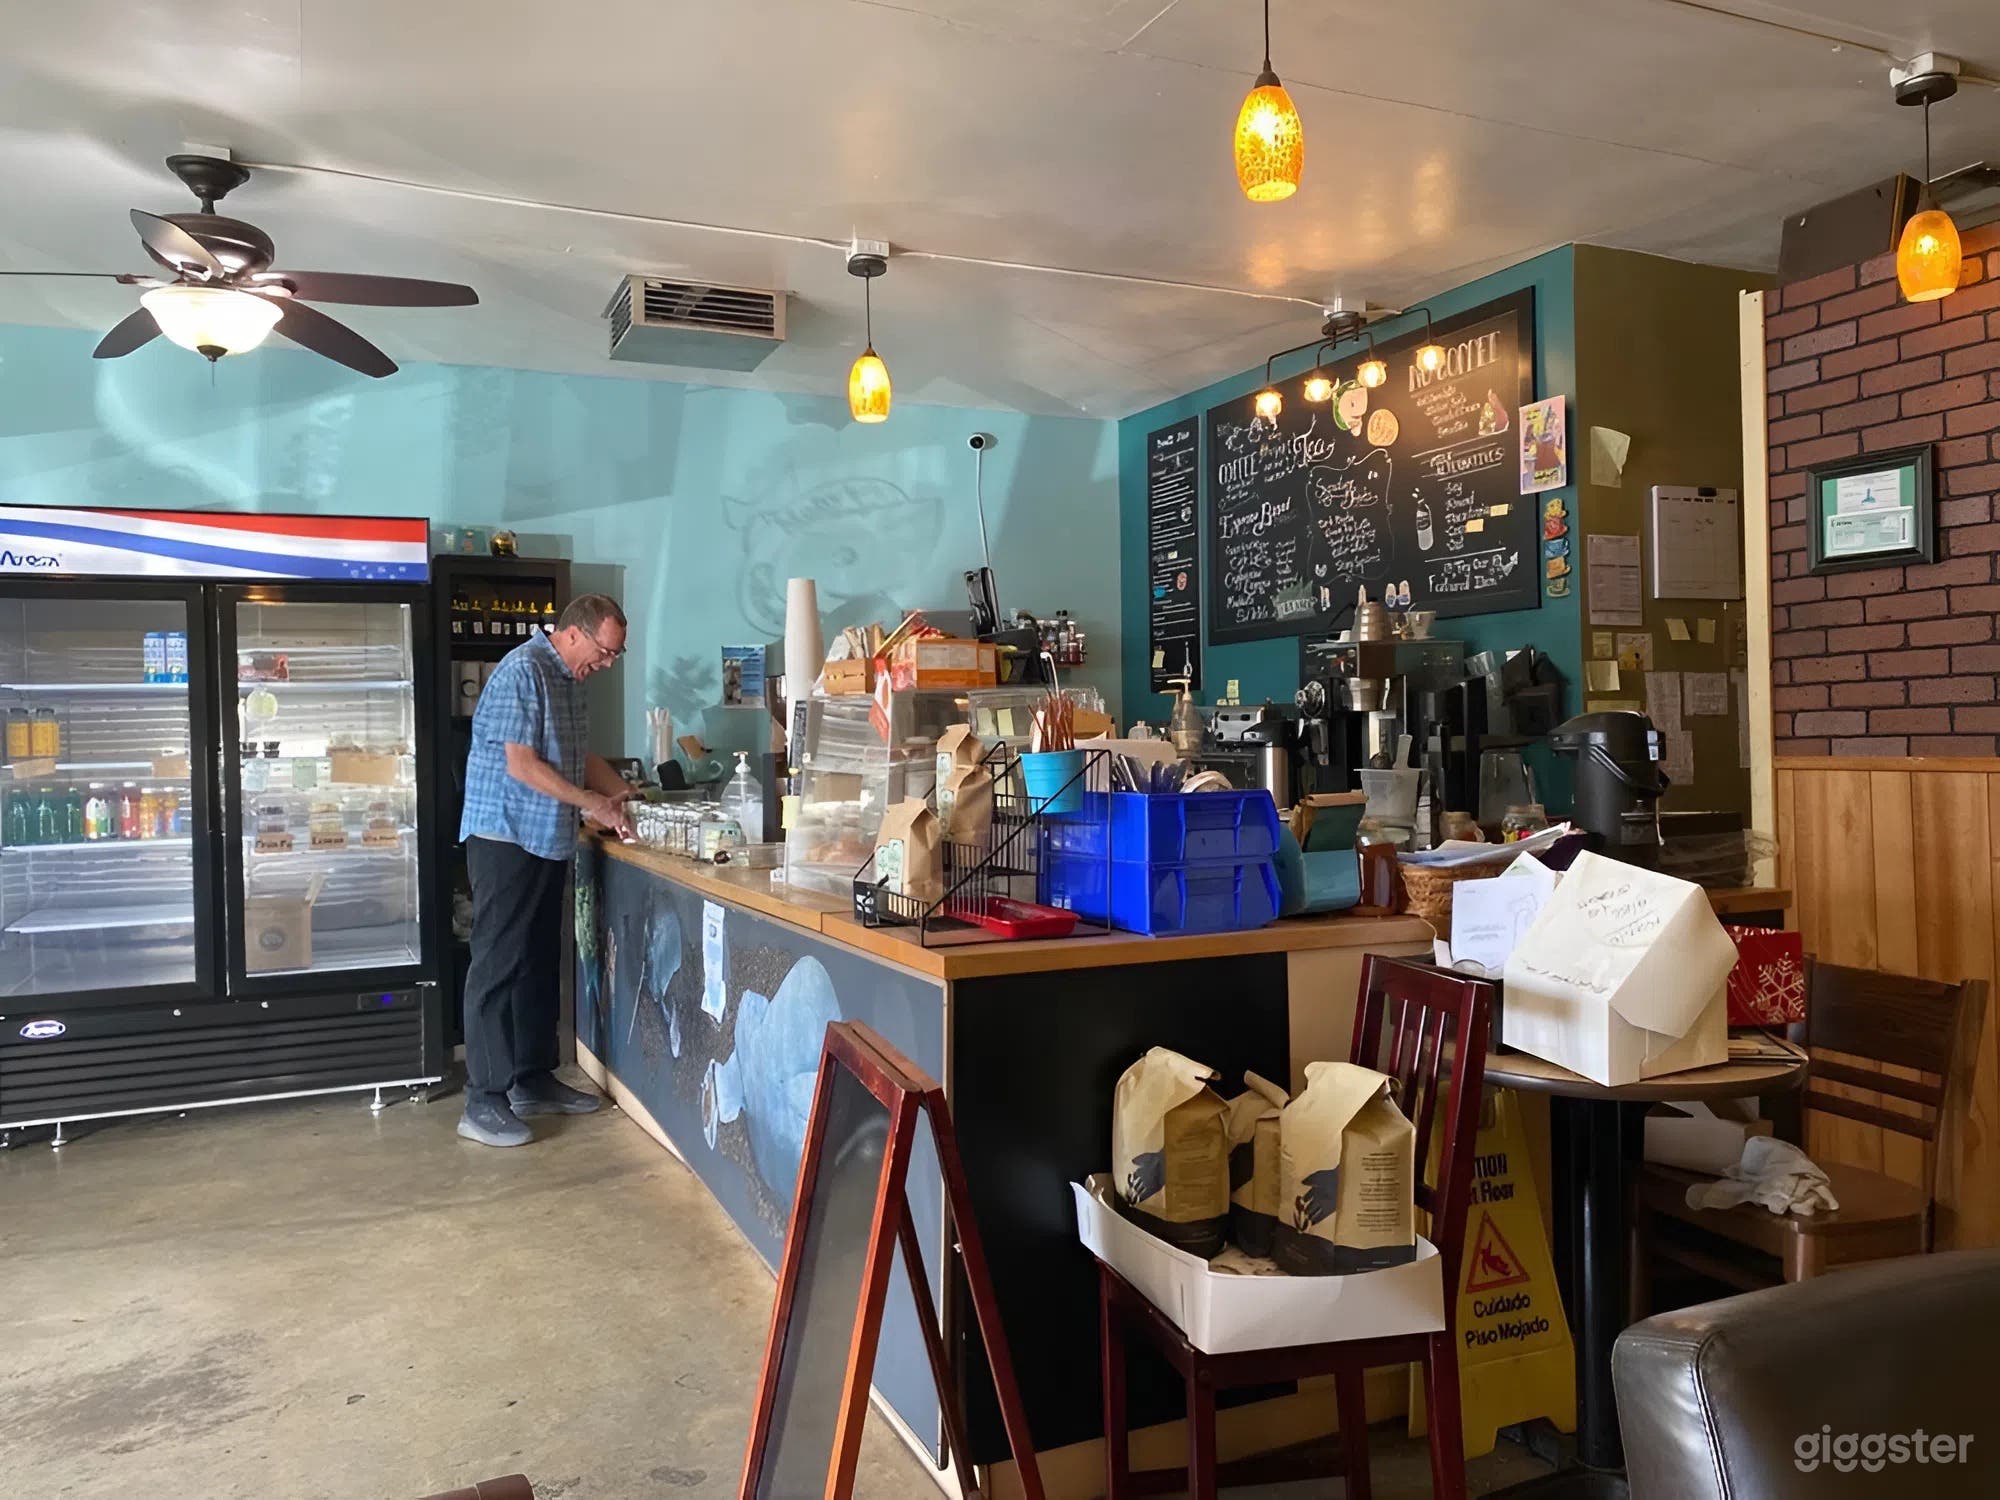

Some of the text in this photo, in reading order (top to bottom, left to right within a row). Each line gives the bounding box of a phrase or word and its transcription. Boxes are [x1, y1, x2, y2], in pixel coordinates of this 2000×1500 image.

[1473, 1293, 1531, 1318] Cuidado
[1465, 1316, 1550, 1349] Piso Mojado
